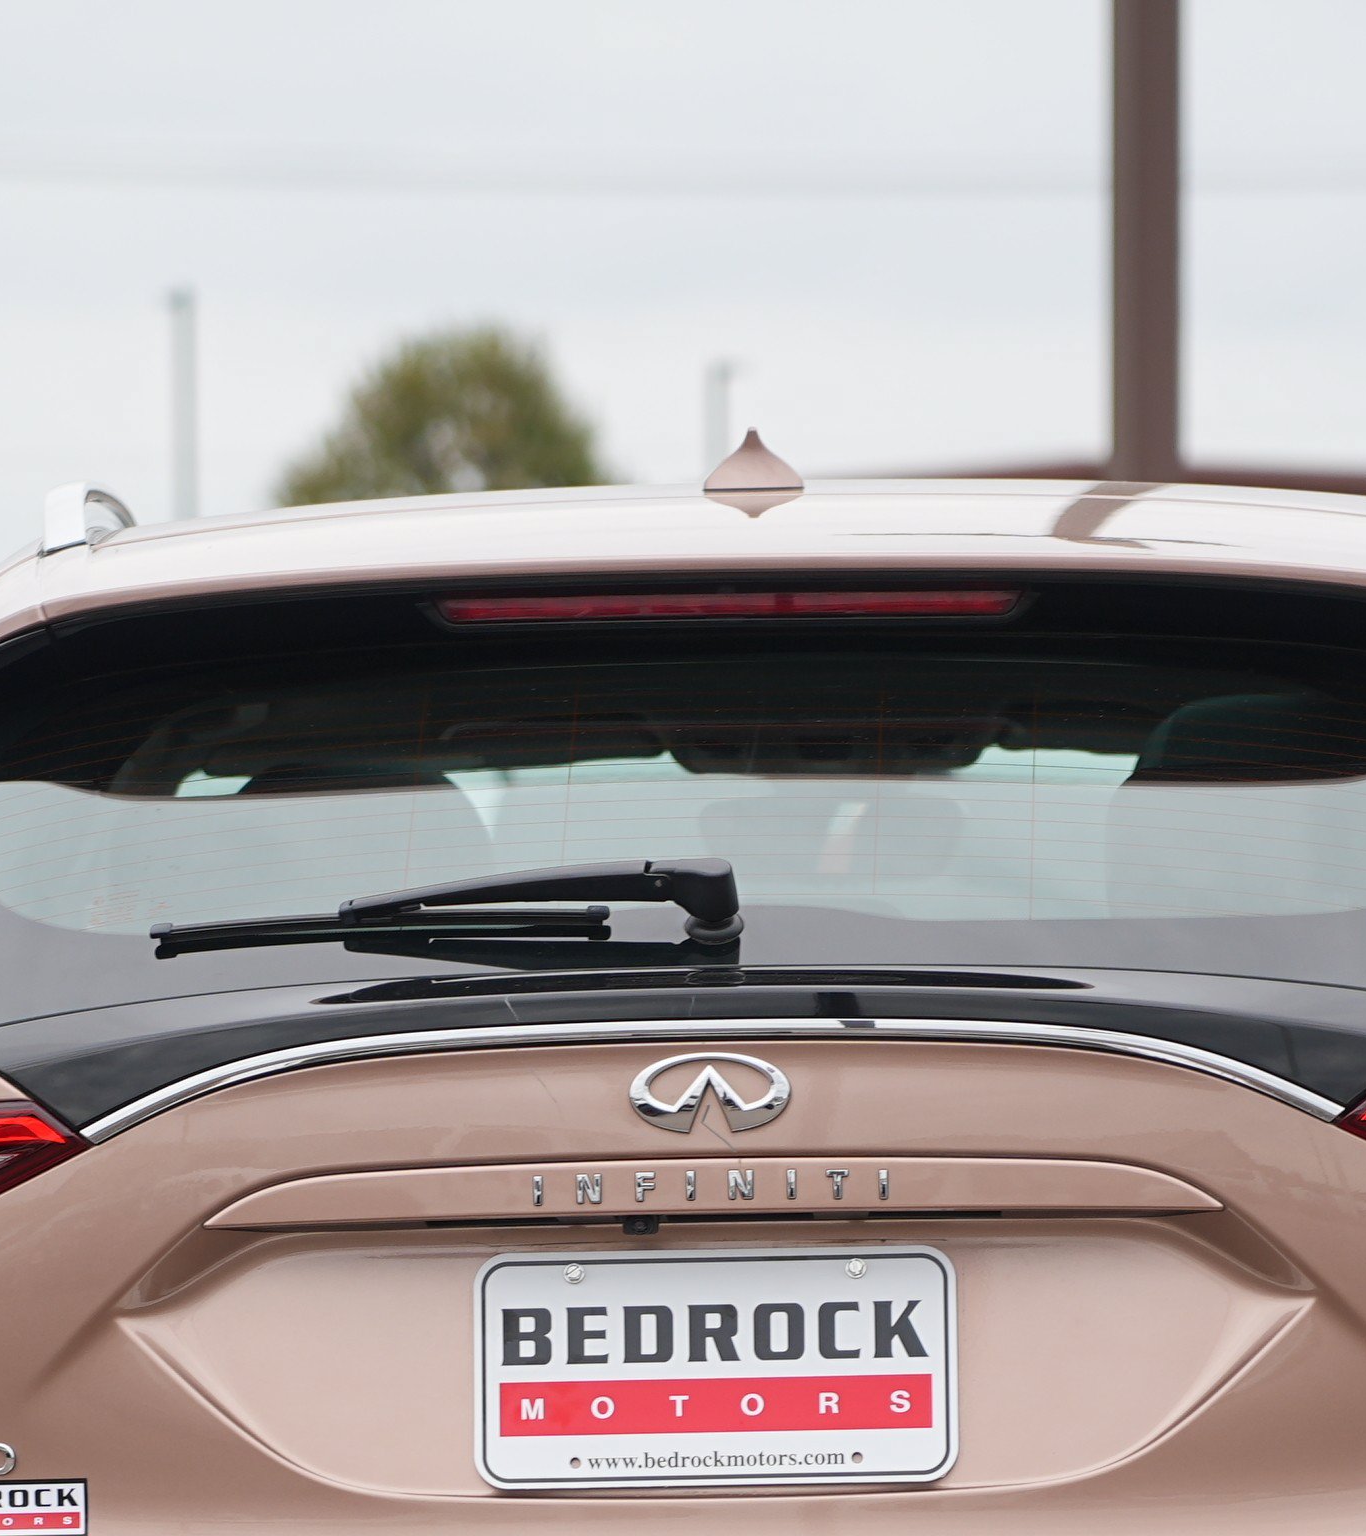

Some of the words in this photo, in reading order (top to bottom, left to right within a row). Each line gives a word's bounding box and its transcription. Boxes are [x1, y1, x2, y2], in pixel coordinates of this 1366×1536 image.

[532, 1168, 890, 1205] INFINITI
[500, 1300, 929, 1366] BEDROCK
[520, 1390, 912, 1421] MOTORS
[587, 1448, 846, 1471] www.bedrockmotors.com
